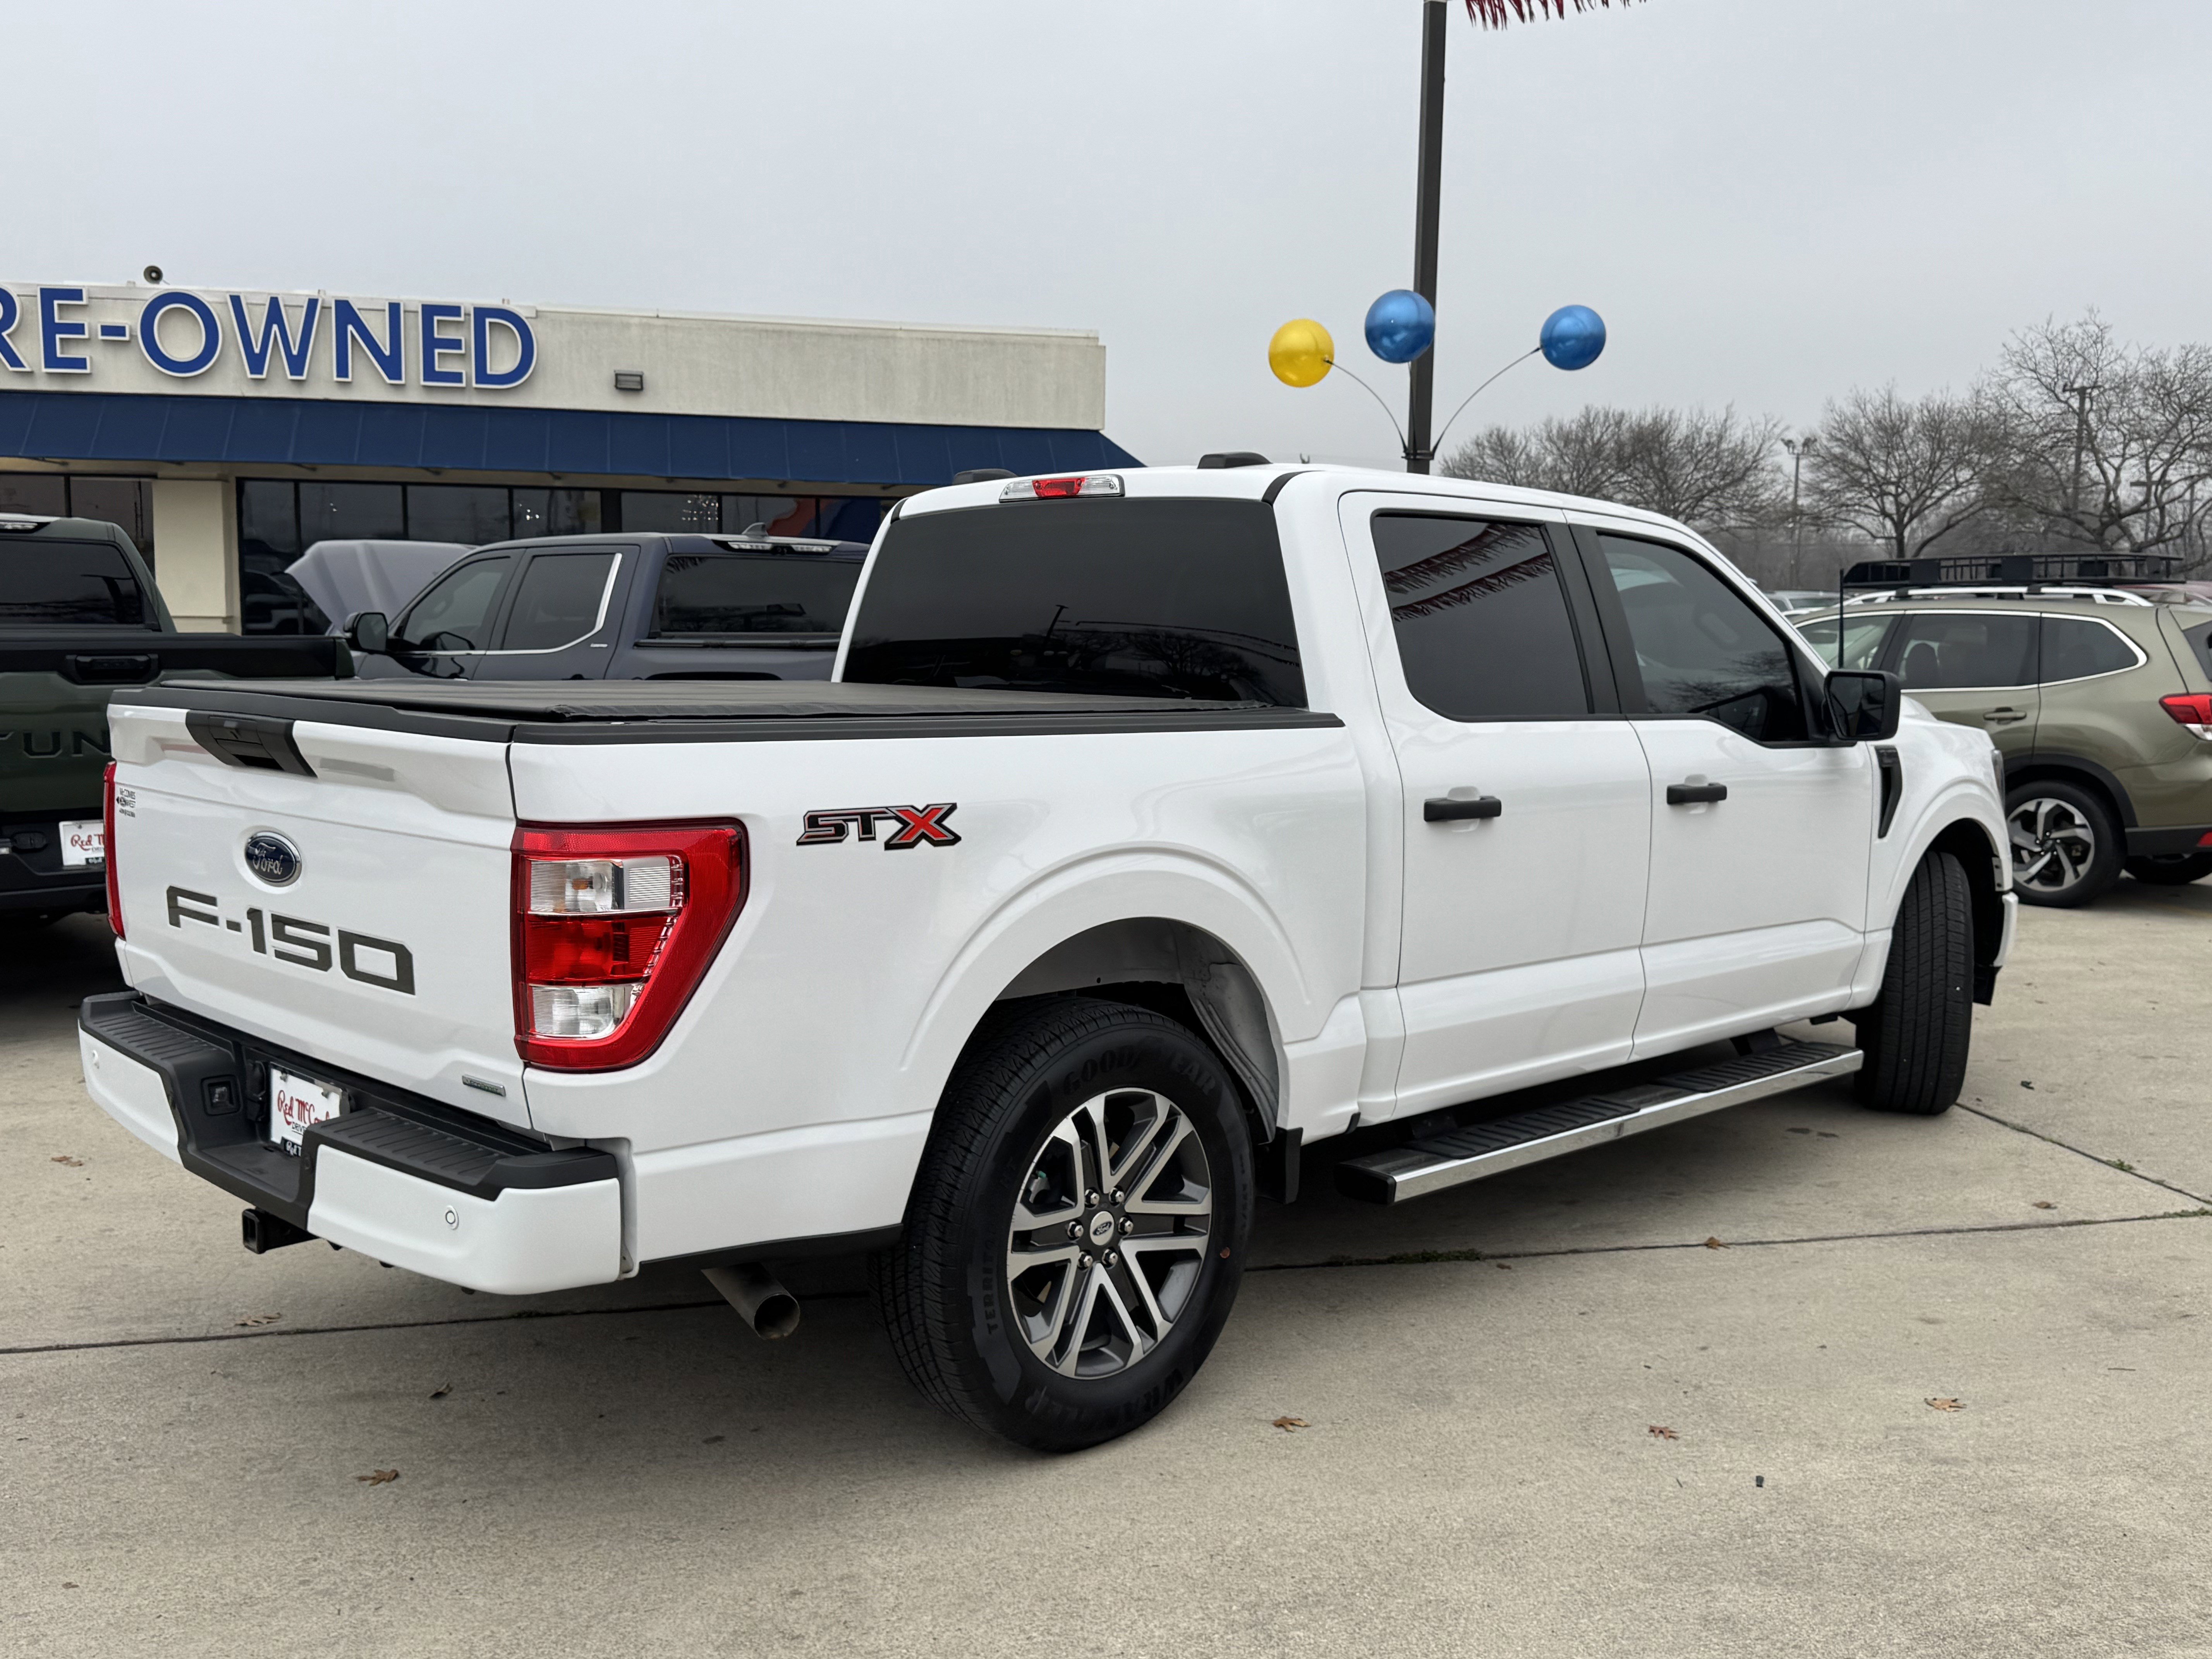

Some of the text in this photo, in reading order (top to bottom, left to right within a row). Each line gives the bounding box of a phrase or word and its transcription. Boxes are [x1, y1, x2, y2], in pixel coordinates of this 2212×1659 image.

[70, 834, 93, 851] Red
[796, 802, 962, 851] STX
[252, 842, 283, 875] Ford
[167, 885, 416, 996] F-150
[1063, 1037, 1218, 1095] GOODEAR
[277, 1090, 294, 1125] Red
